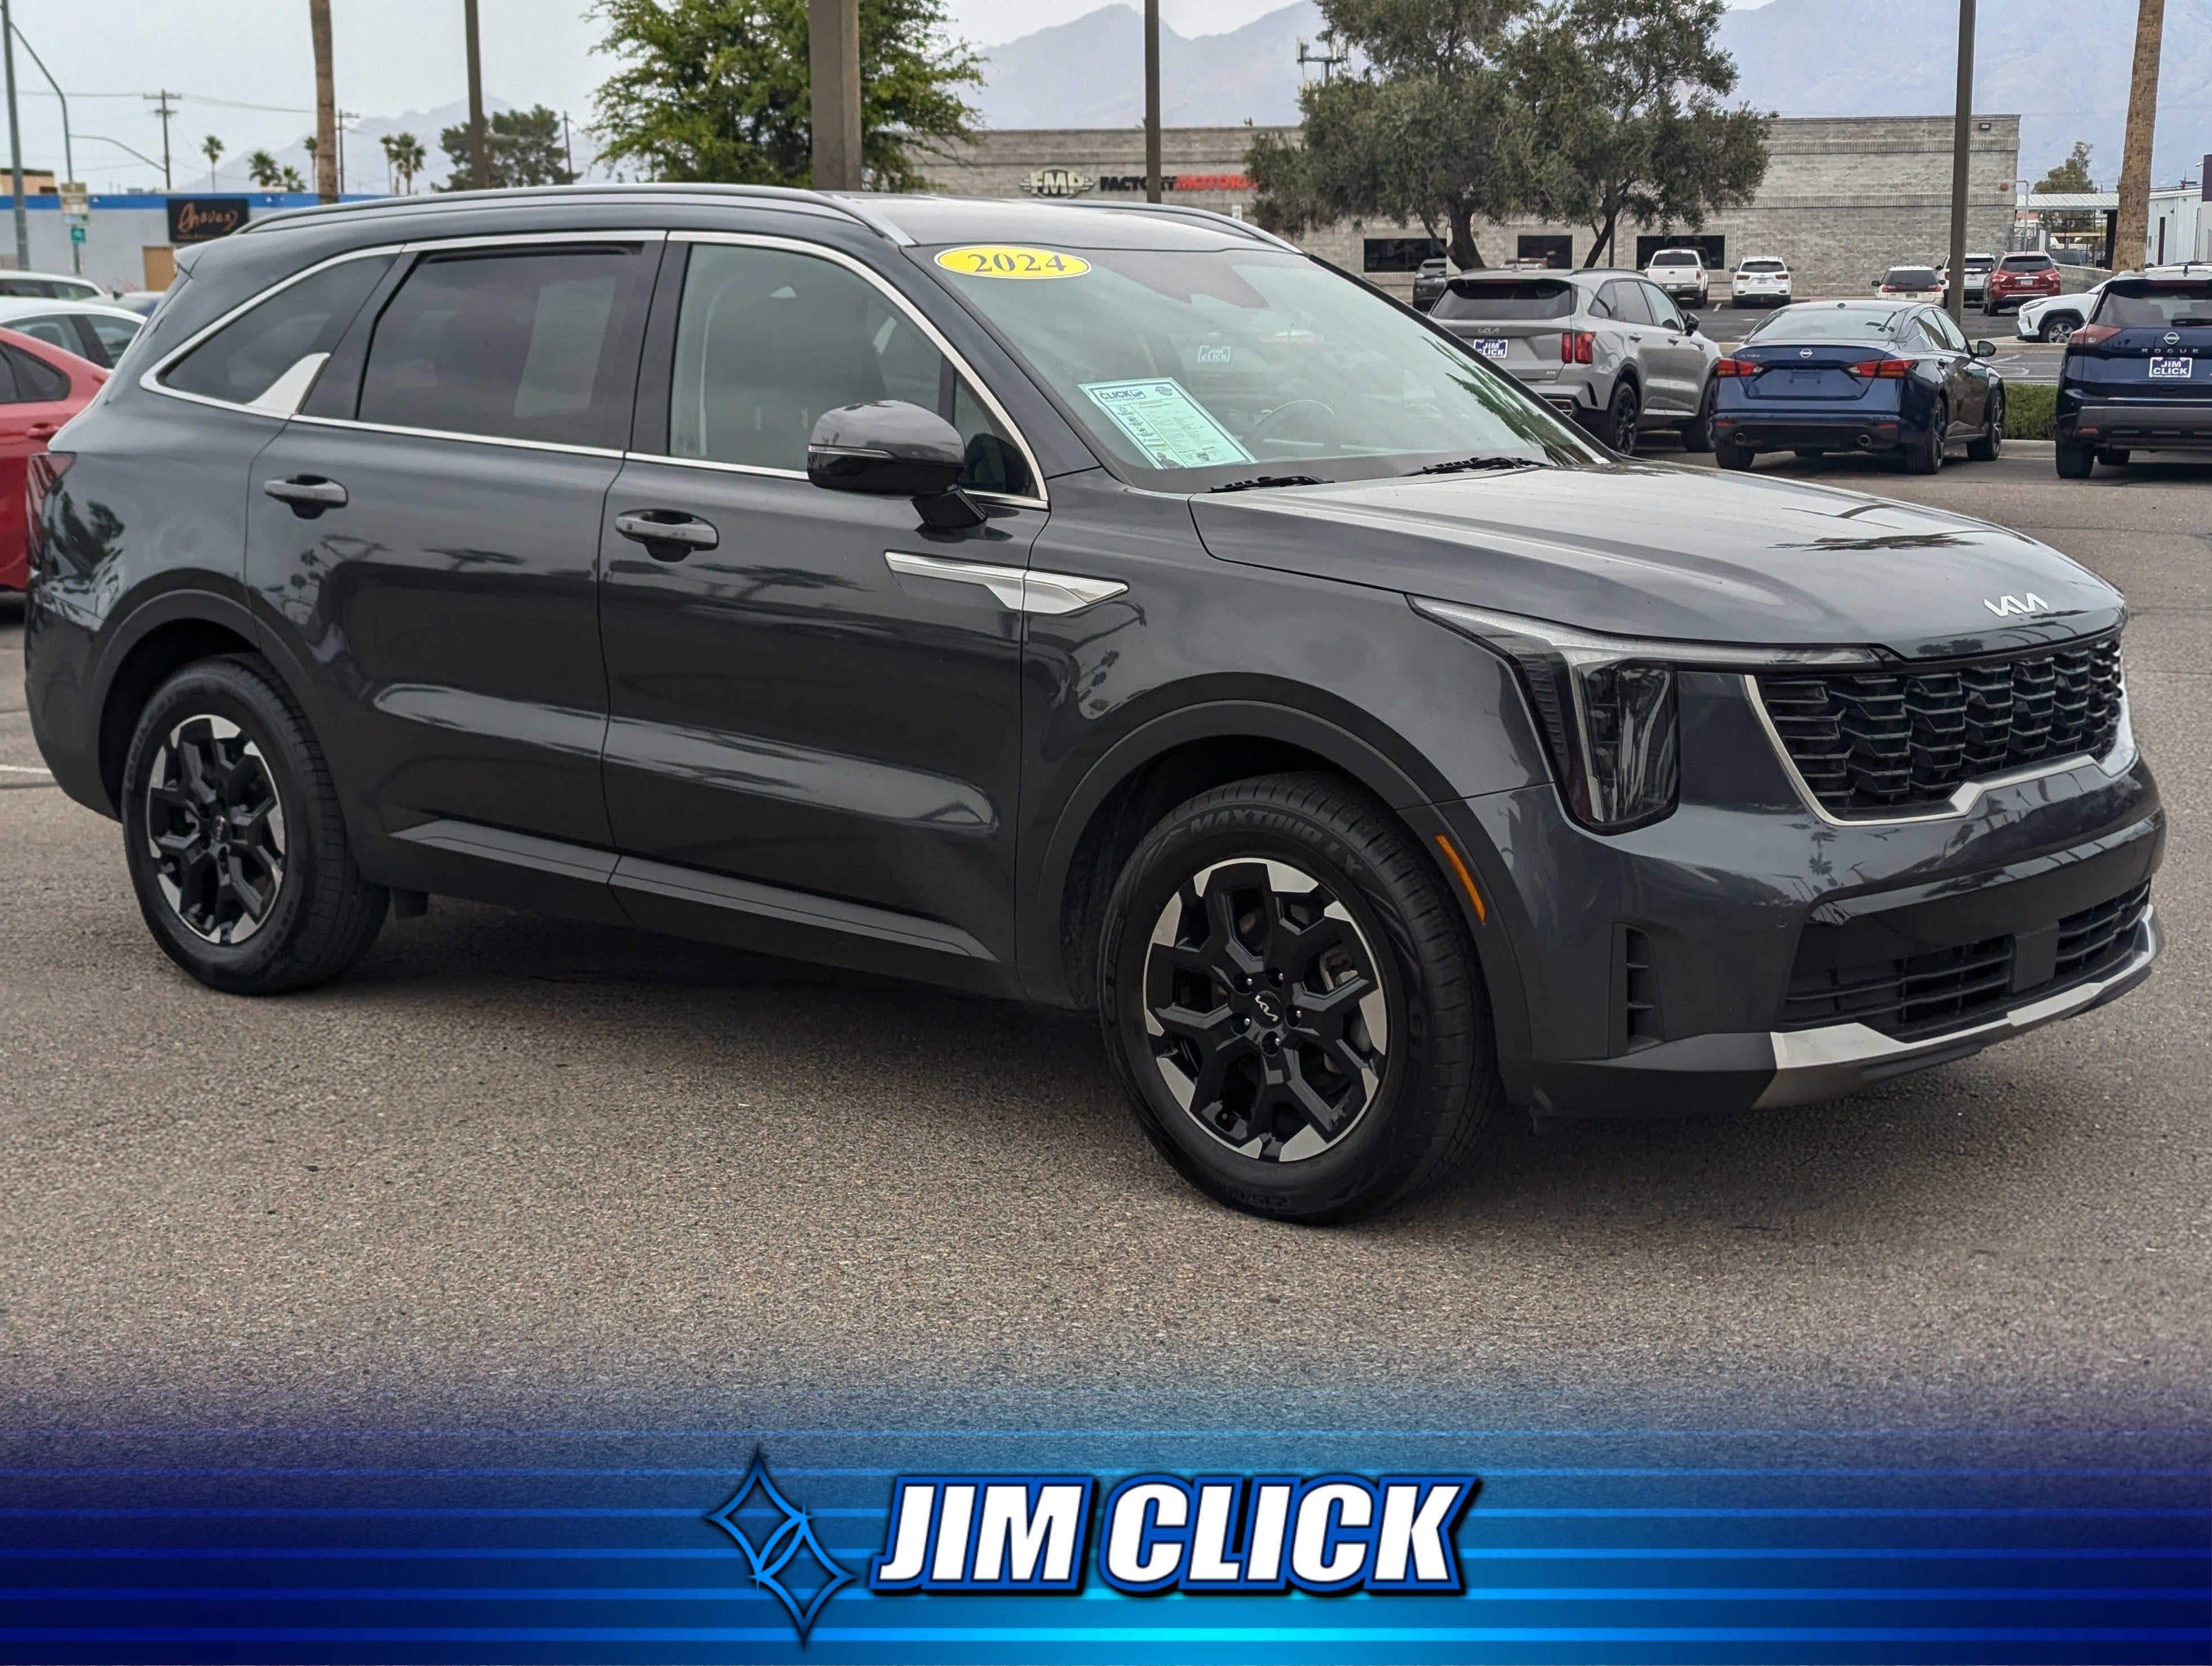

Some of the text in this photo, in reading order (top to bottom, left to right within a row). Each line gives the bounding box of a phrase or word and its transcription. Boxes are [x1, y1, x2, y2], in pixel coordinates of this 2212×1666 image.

[1030, 173, 1084, 195] FMP
[1100, 176, 1177, 191] FACTOY
[967, 254, 1066, 272] 2024
[1100, 390, 1132, 399] CLICK
[1984, 593, 2049, 617] KIA
[1191, 810, 1323, 843] MAXTOUR
